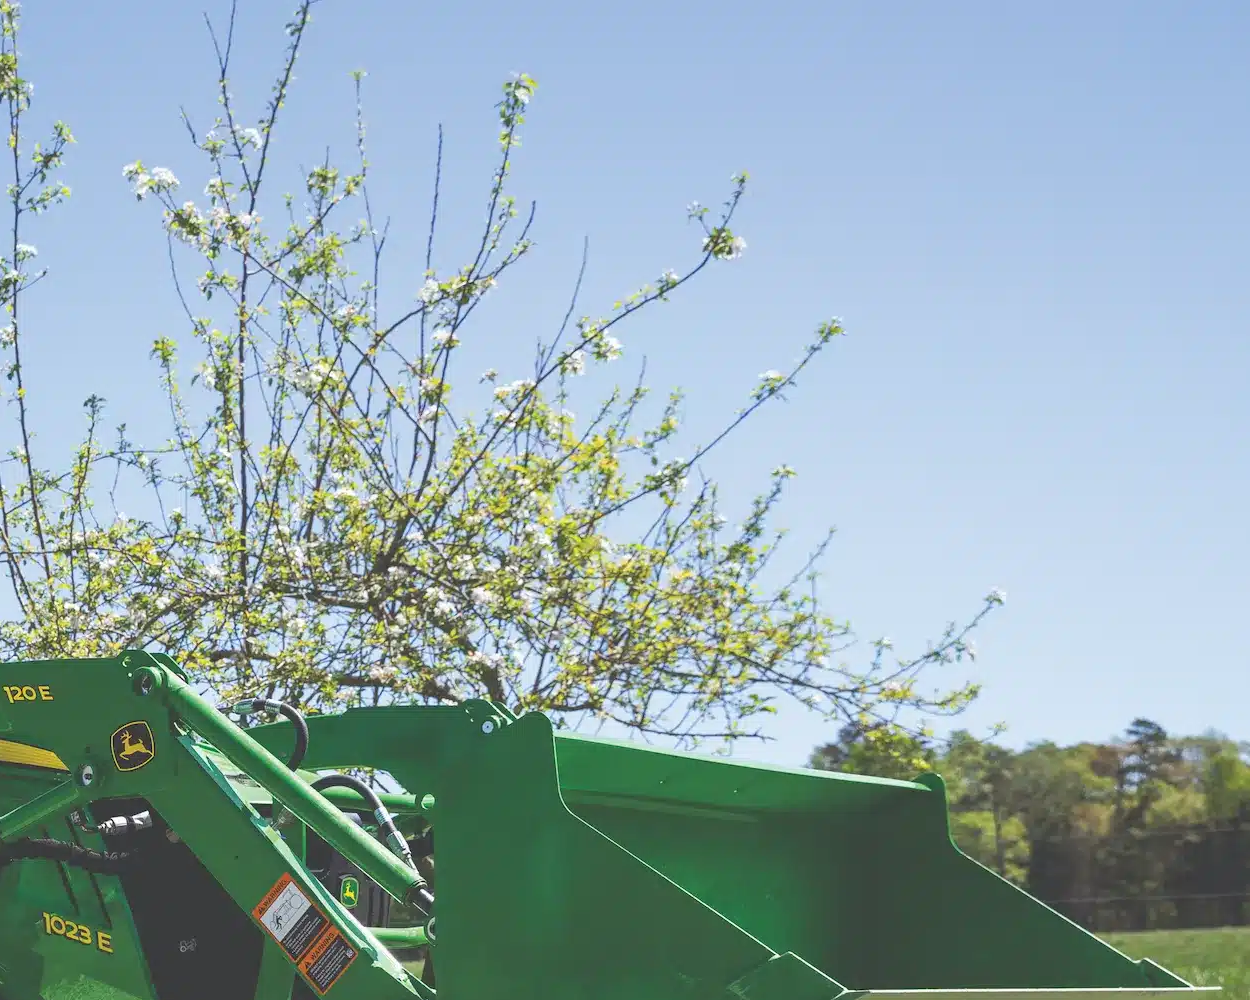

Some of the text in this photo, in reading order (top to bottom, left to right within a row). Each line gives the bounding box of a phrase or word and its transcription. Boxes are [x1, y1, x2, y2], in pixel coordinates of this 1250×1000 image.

[3, 686, 54, 703] 120 E
[263, 879, 288, 908] WARNING
[43, 911, 113, 953] 1023 E
[311, 932, 335, 961] WARNING
